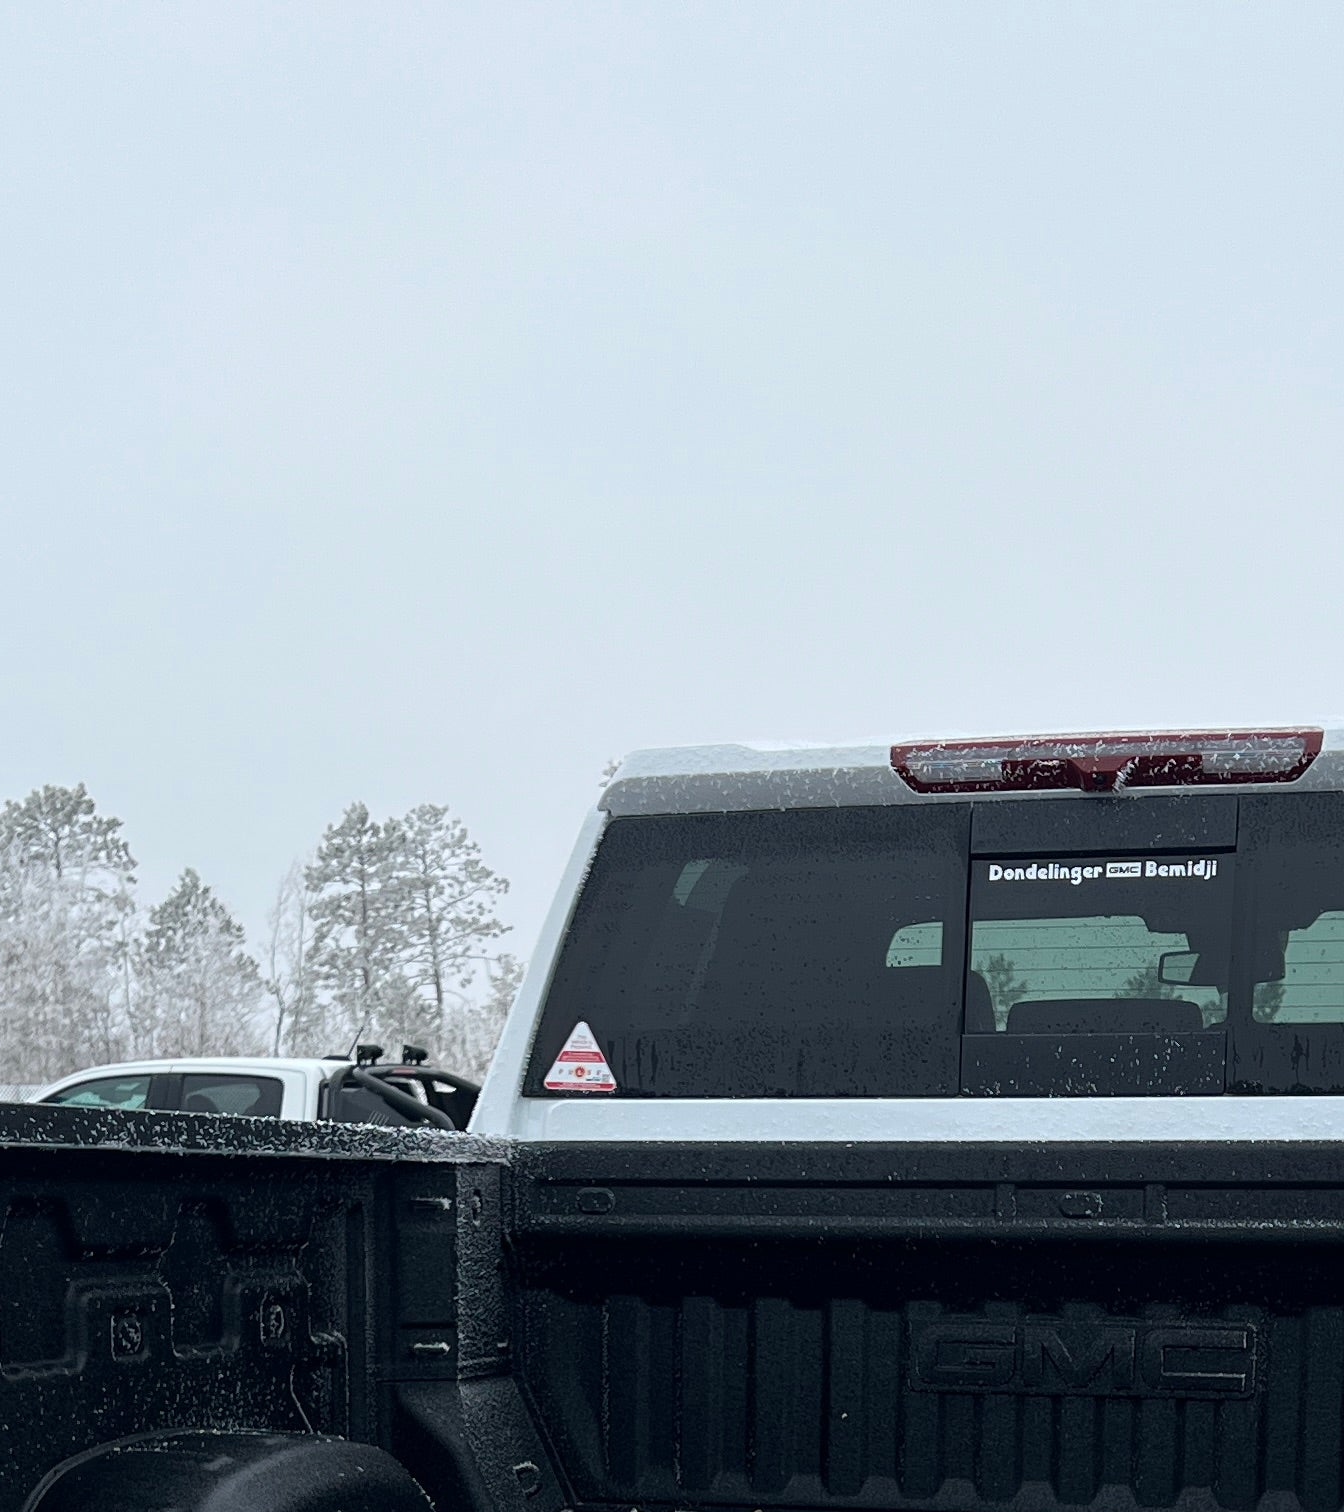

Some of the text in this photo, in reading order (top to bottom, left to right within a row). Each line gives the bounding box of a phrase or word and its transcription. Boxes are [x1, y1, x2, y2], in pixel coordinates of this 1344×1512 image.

[989, 860, 1218, 885] Dondelinger GMC Bemidji
[913, 1325, 1248, 1393] GMC
